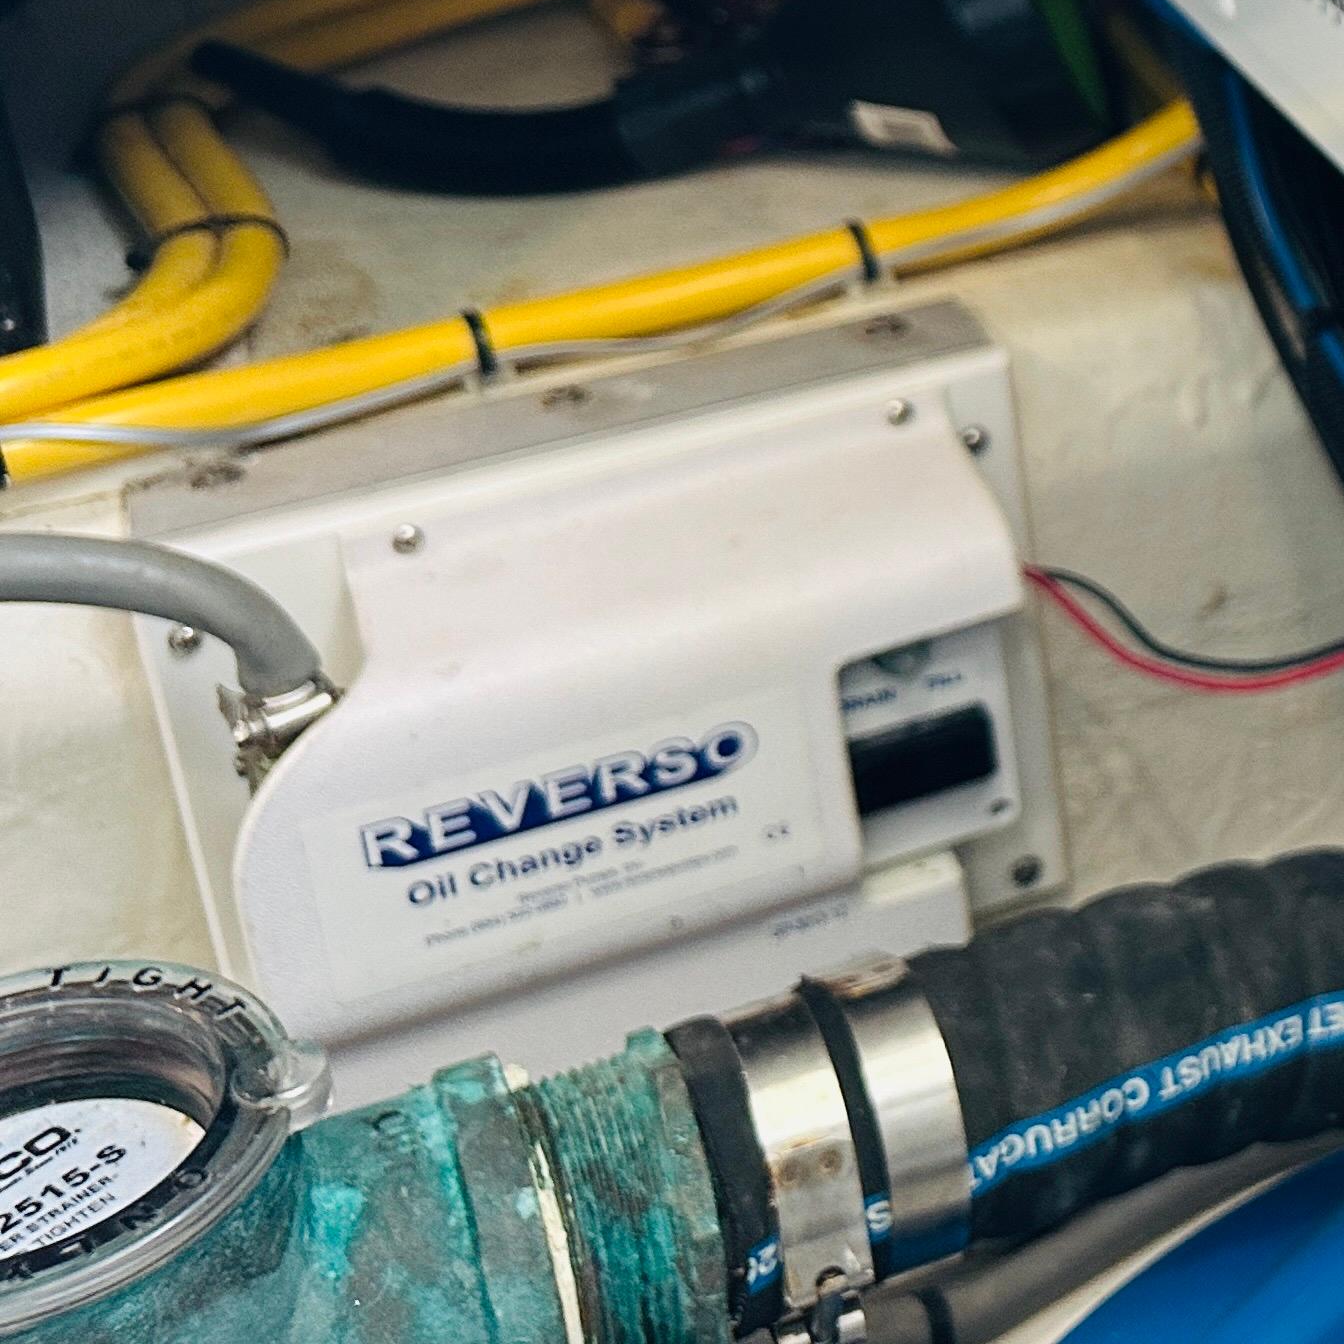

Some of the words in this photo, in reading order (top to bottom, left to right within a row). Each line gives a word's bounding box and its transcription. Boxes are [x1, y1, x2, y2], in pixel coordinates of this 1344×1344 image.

[361, 719, 760, 871] REVERSO
[406, 870, 458, 907] Oil
[468, 836, 603, 890] Change
[612, 793, 740, 853] System
[45, 966, 248, 1018] TIGHT
[1158, 1014, 1305, 1104] EXHAUST
